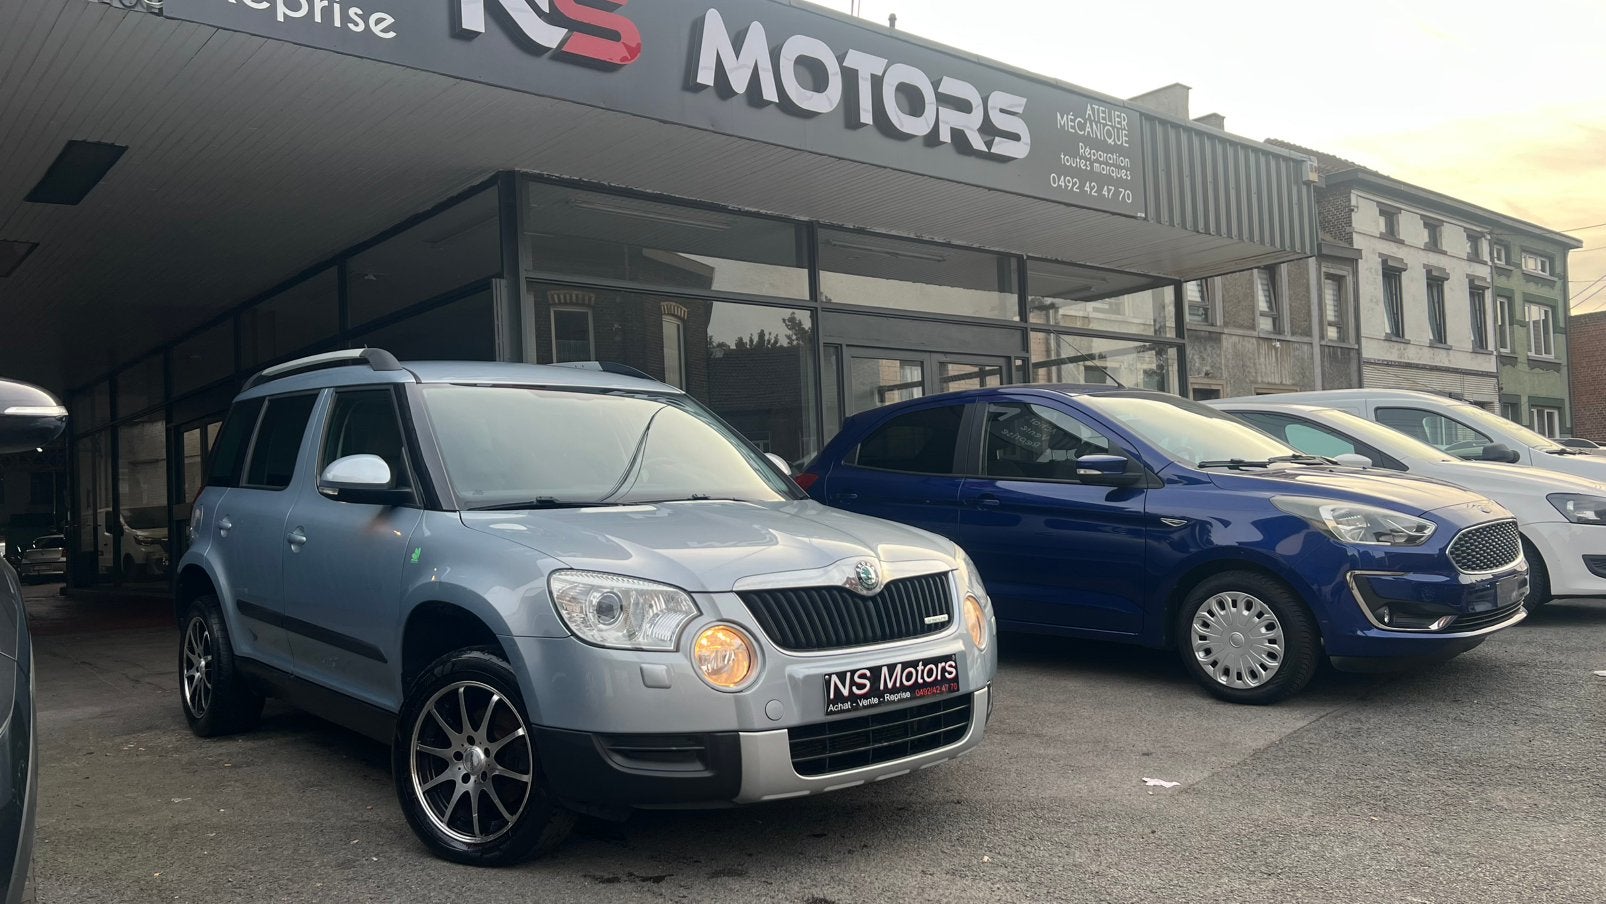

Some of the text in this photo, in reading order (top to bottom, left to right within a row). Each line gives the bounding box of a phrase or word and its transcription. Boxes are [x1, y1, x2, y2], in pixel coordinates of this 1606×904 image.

[228, 0, 397, 39] prise
[696, 8, 1031, 158] MOTORS
[1056, 111, 1129, 147] MÉCANIQUE
[1085, 103, 1128, 130] ATELIER
[1060, 152, 1131, 180] toutes marques
[1079, 142, 1131, 168] Réparation
[1050, 173, 1133, 203] 0492 42 47 70
[829, 660, 957, 700] NS Motors
[827, 701, 852, 712] Achat
[857, 697, 879, 707] Vente
[884, 691, 911, 702] Reprise
